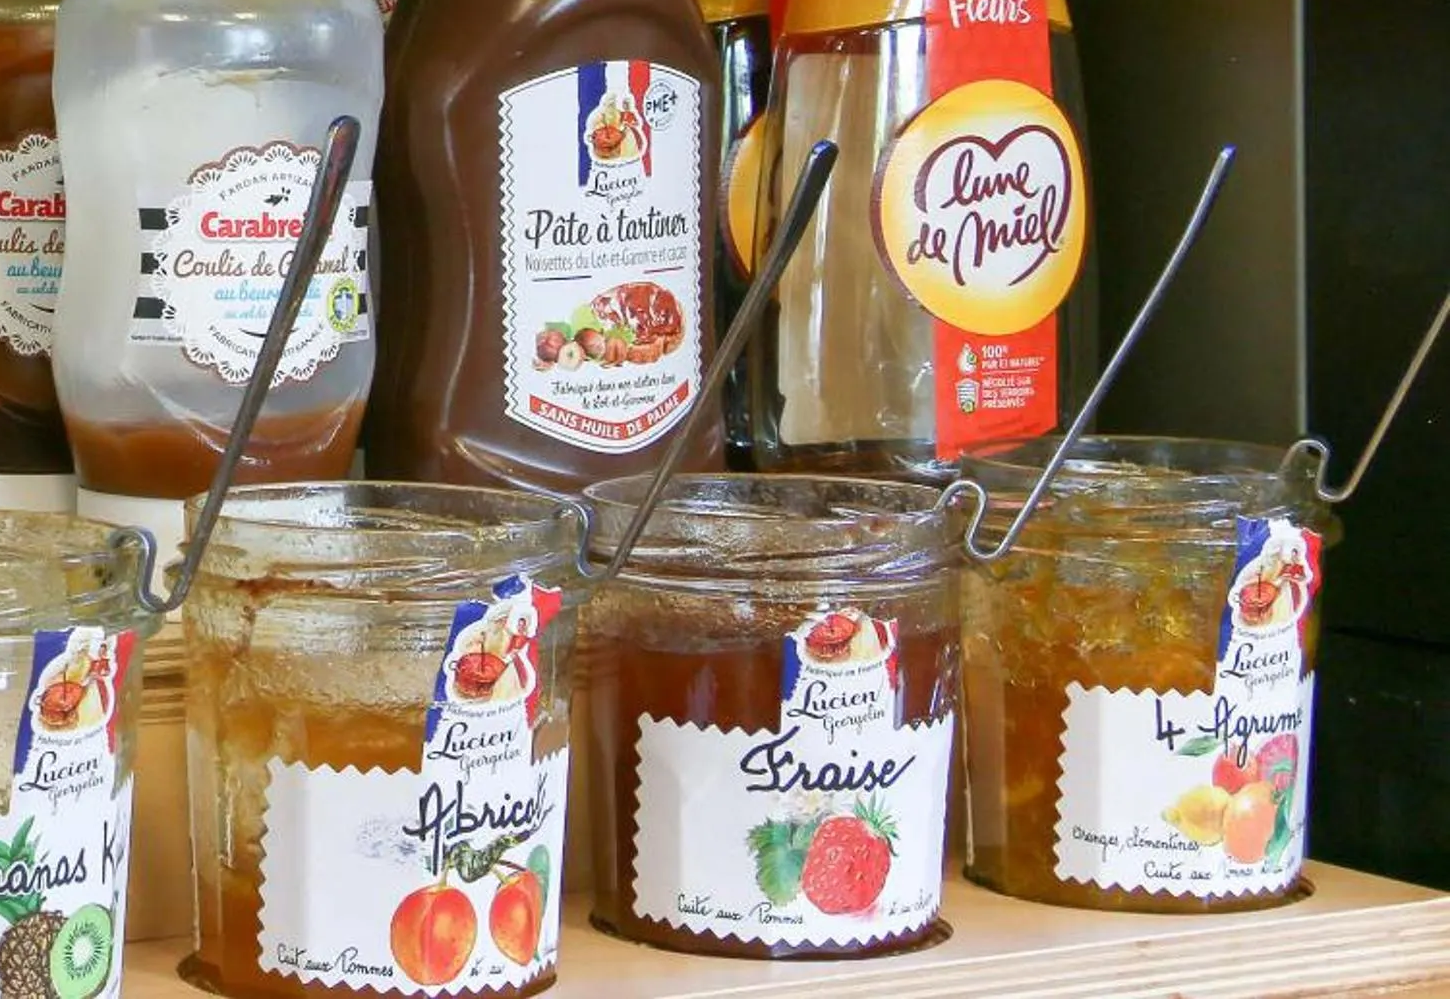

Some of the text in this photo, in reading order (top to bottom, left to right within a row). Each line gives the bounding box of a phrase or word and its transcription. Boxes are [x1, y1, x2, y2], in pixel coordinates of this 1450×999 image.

[940, 148, 1040, 206] lune
[201, 211, 308, 239] Carabre
[524, 206, 689, 249] Pâte à tartiner
[907, 222, 948, 265] de
[173, 249, 246, 279] Coulis
[251, 250, 275, 276] de
[538, 393, 680, 439] SANS HUILE DE PALME
[1217, 642, 1290, 679] Lucien
[787, 679, 876, 720] Lucien
[427, 721, 514, 760] Lucien
[1156, 698, 1186, 751] 4
[18, 750, 98, 792] Lucien
[739, 725, 917, 793] Fraise
